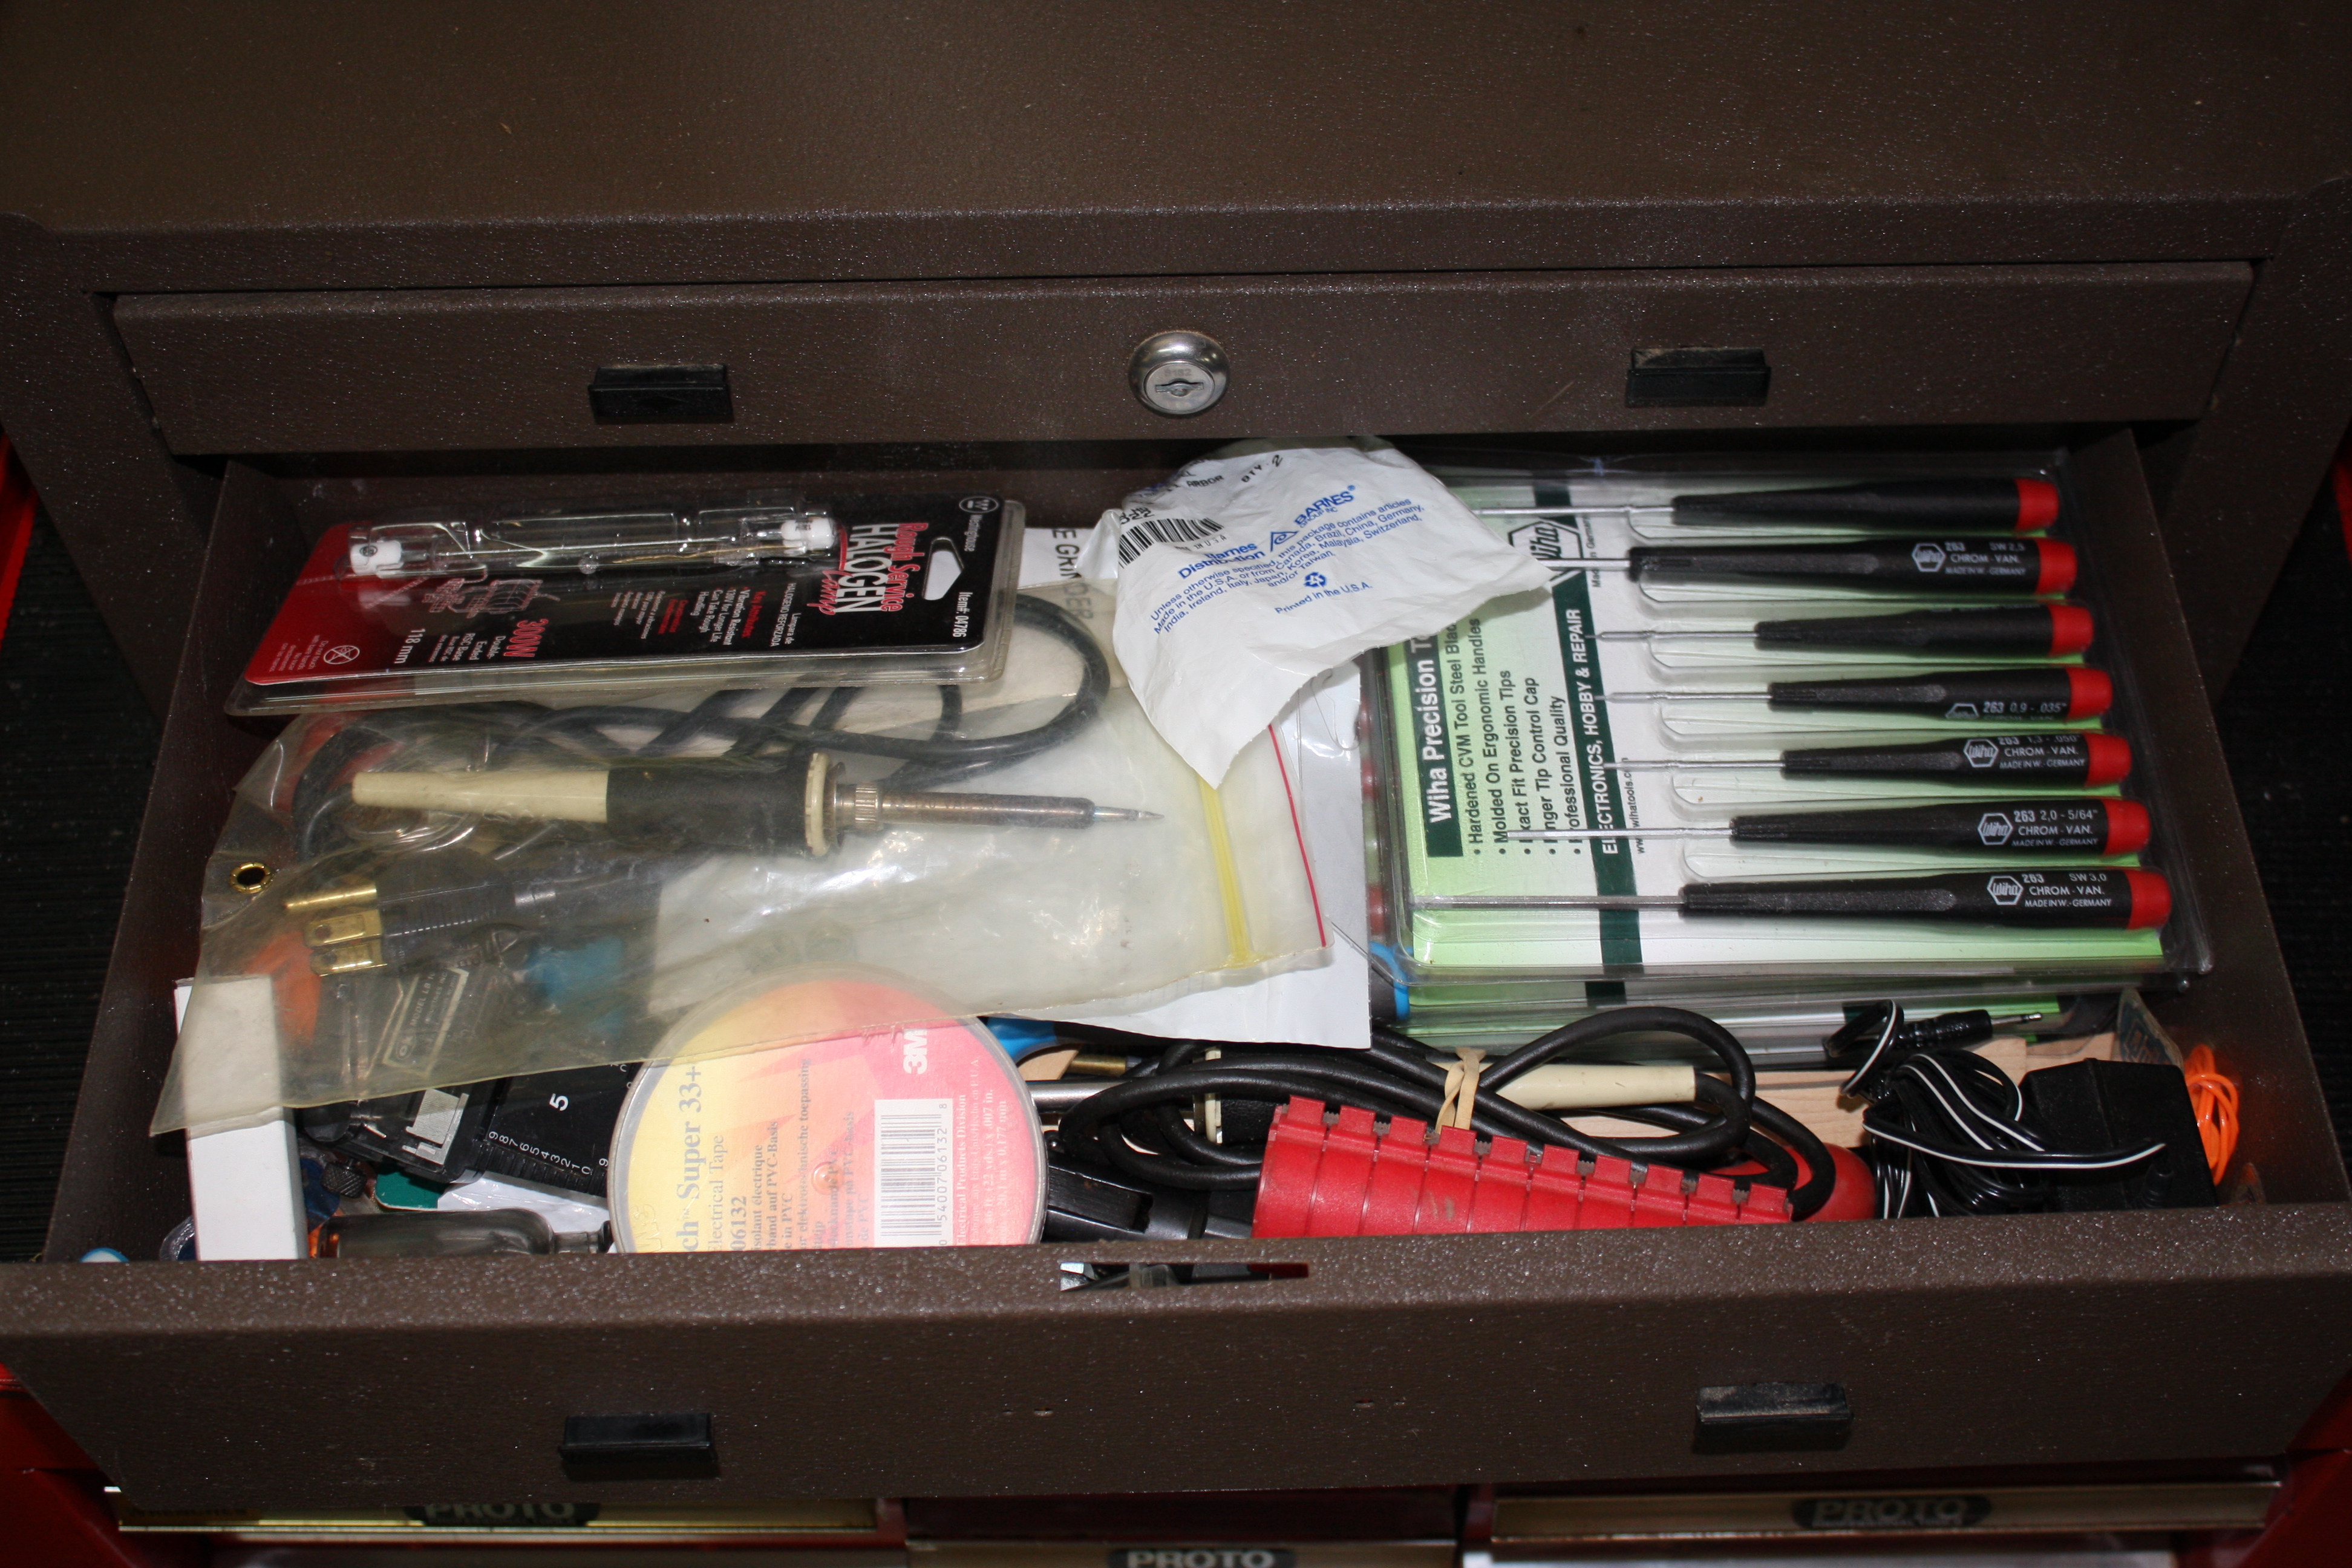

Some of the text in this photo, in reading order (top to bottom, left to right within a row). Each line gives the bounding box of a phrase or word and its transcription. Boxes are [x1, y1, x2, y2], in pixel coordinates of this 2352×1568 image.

[1186, 475, 1224, 488] ARBOR
[1272, 454, 1283, 468] 2
[1294, 491, 1354, 525] BARNES
[1299, 510, 1324, 528] GROUP
[964, 515, 982, 552] Westinghouse
[835, 524, 900, 613] HALOGEN
[880, 523, 929, 612] Rough Service
[1150, 593, 1182, 621] Unless
[1183, 570, 1230, 595] otherwise
[1278, 546, 1296, 559] this
[1296, 523, 1336, 545] package
[1337, 509, 1377, 528] contains
[1377, 499, 1412, 513] articles
[1153, 607, 1175, 635] Made
[1175, 601, 1186, 609] in
[1186, 590, 1204, 602] the
[1250, 567, 1275, 578] from
[1315, 531, 1345, 543] Brazil,
[1344, 520, 1378, 537] China,
[1377, 505, 1424, 523] Germany,
[1163, 610, 1189, 633] India,
[1188, 587, 1227, 610] Ireland,
[1363, 514, 1423, 540] Switzerland,
[1177, 550, 1266, 580] Distribution
[1268, 570, 1298, 587] and/or
[1950, 554, 1989, 563] CHROM
[690, 591, 709, 616] Handling
[699, 589, 723, 633] Can Take Rough
[725, 589, 736, 603] 130V
[807, 570, 854, 615] Lamp
[1275, 595, 1313, 615] Printed
[1313, 590, 1324, 599] in
[1324, 587, 1341, 598] the
[713, 613, 729, 631] Longer
[723, 589, 751, 645] Vibration Resistant
[771, 583, 796, 647] HALOGENO REFORZADA
[953, 616, 969, 637] 04786
[1566, 607, 1589, 663] REPAIR
[394, 628, 426, 664] 118 mm
[452, 633, 475, 661] RSC Base
[468, 641, 487, 660] Ended
[503, 619, 549, 657] 300W
[710, 633, 722, 642] Life
[1576, 667, 1590, 678] &
[1550, 696, 1567, 745] Quality
[1578, 681, 1599, 736] HOBBY
[1983, 701, 2004, 713] 263
[1415, 659, 1452, 823] Wiha Precision
[1449, 659, 1483, 843] Hardened CVM Tool Steel
[1468, 618, 1509, 843] Molded On Ergonomic Handles
[1498, 670, 1528, 799] Fit Precision Tips
[1524, 678, 1552, 792] Tip Control Cap
[2004, 747, 2045, 757] CHROM
[2014, 810, 2035, 822] 263
[2018, 826, 2058, 835] CHROM
[2022, 873, 2087, 883] 263 SW
[2029, 886, 2069, 896] CHROM
[410, 998, 426, 1026] MODEL
[903, 1029, 927, 1074] 3M
[549, 1093, 569, 1111] 5
[799, 1059, 811, 1122] toepassing
[676, 1065, 706, 1199] Super 33+
[937, 1128, 947, 1172] 06132
[767, 1122, 779, 1210] auf PVC-Basis
[956, 1094, 966, 1246] Electrical Products Division
[708, 1135, 728, 1252] Electrical Tape
[751, 1145, 765, 1251] isolant électrique
[858, 1194, 869, 1222] PVC
[937, 1177, 947, 1221] 54007
[730, 1195, 746, 1251] 06132
[781, 1193, 792, 1240] in PVC
